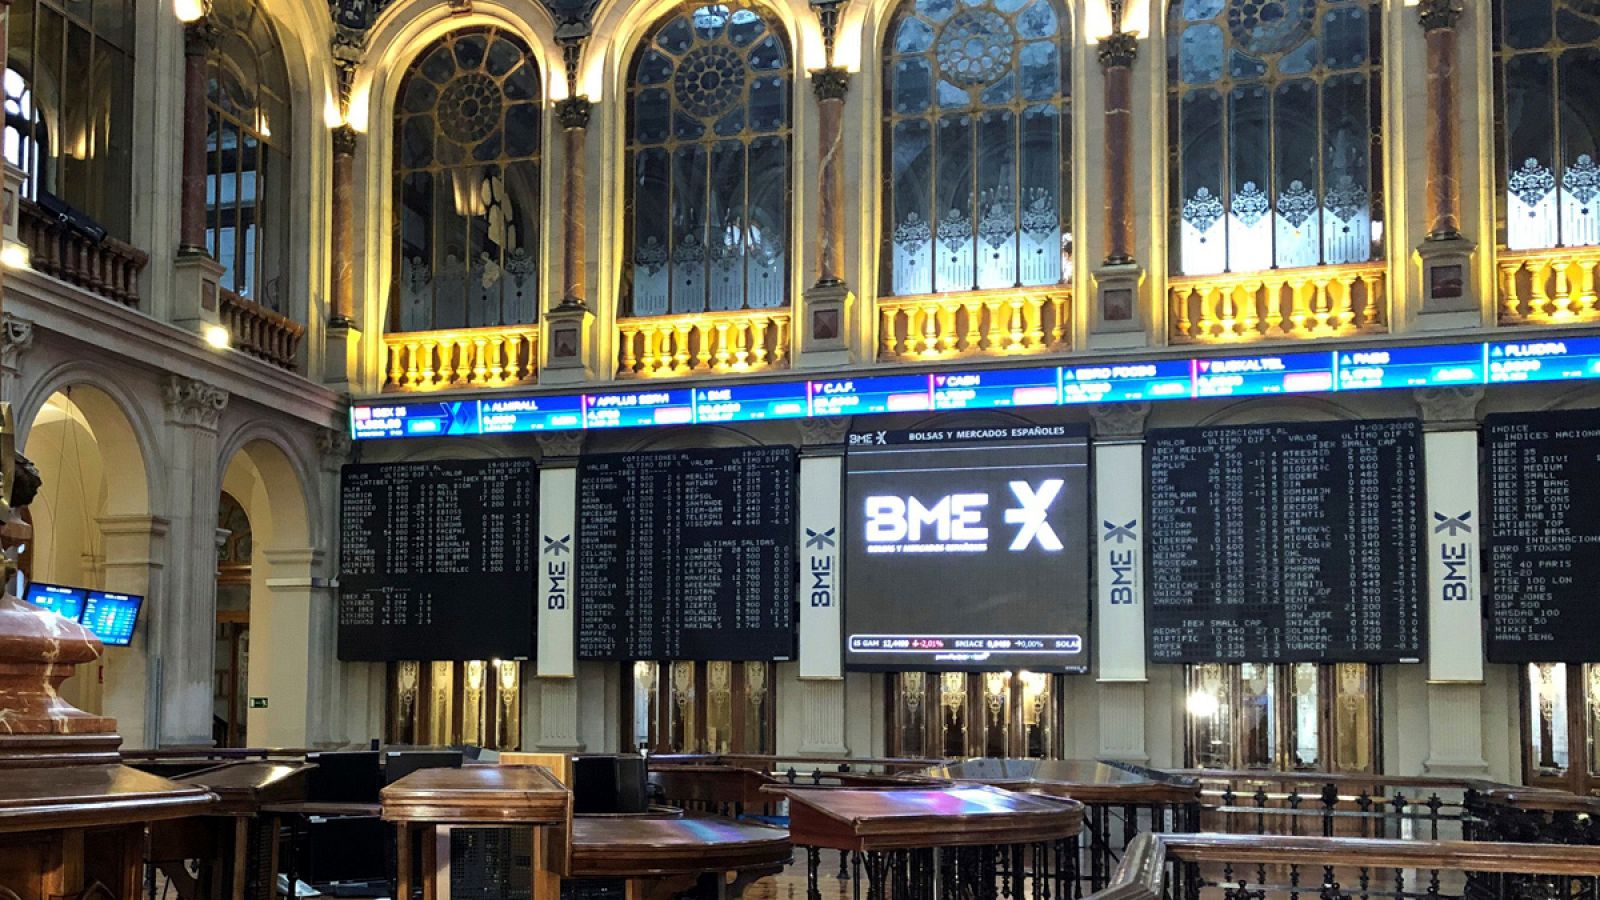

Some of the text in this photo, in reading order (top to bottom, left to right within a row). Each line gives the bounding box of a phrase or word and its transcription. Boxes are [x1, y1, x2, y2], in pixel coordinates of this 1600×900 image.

[1506, 343, 1567, 356] FLUIDRA
[492, 401, 538, 411] ALMIRALL
[1202, 428, 1271, 438] COTIZACIONES
[1491, 425, 1528, 433] INDICE
[849, 434, 873, 445] BME
[908, 432, 944, 440] BOLSAS
[956, 428, 1008, 438] MERCADOS
[1012, 426, 1065, 437] ESPAÑOLES
[1341, 432, 1378, 440] ULTIMO
[1504, 432, 1548, 440] INDICES
[1524, 463, 1562, 472] MEDIUM
[1524, 472, 1556, 480] SMALL
[866, 494, 988, 542] BME
[1492, 520, 1537, 528] LATIBEX
[1493, 528, 1538, 536] LATIBEX
[1526, 544, 1571, 552] STOXX50
[1441, 542, 1468, 600] BME
[812, 555, 830, 607] BME
[1110, 550, 1132, 604] BME
[548, 561, 565, 610] BME
